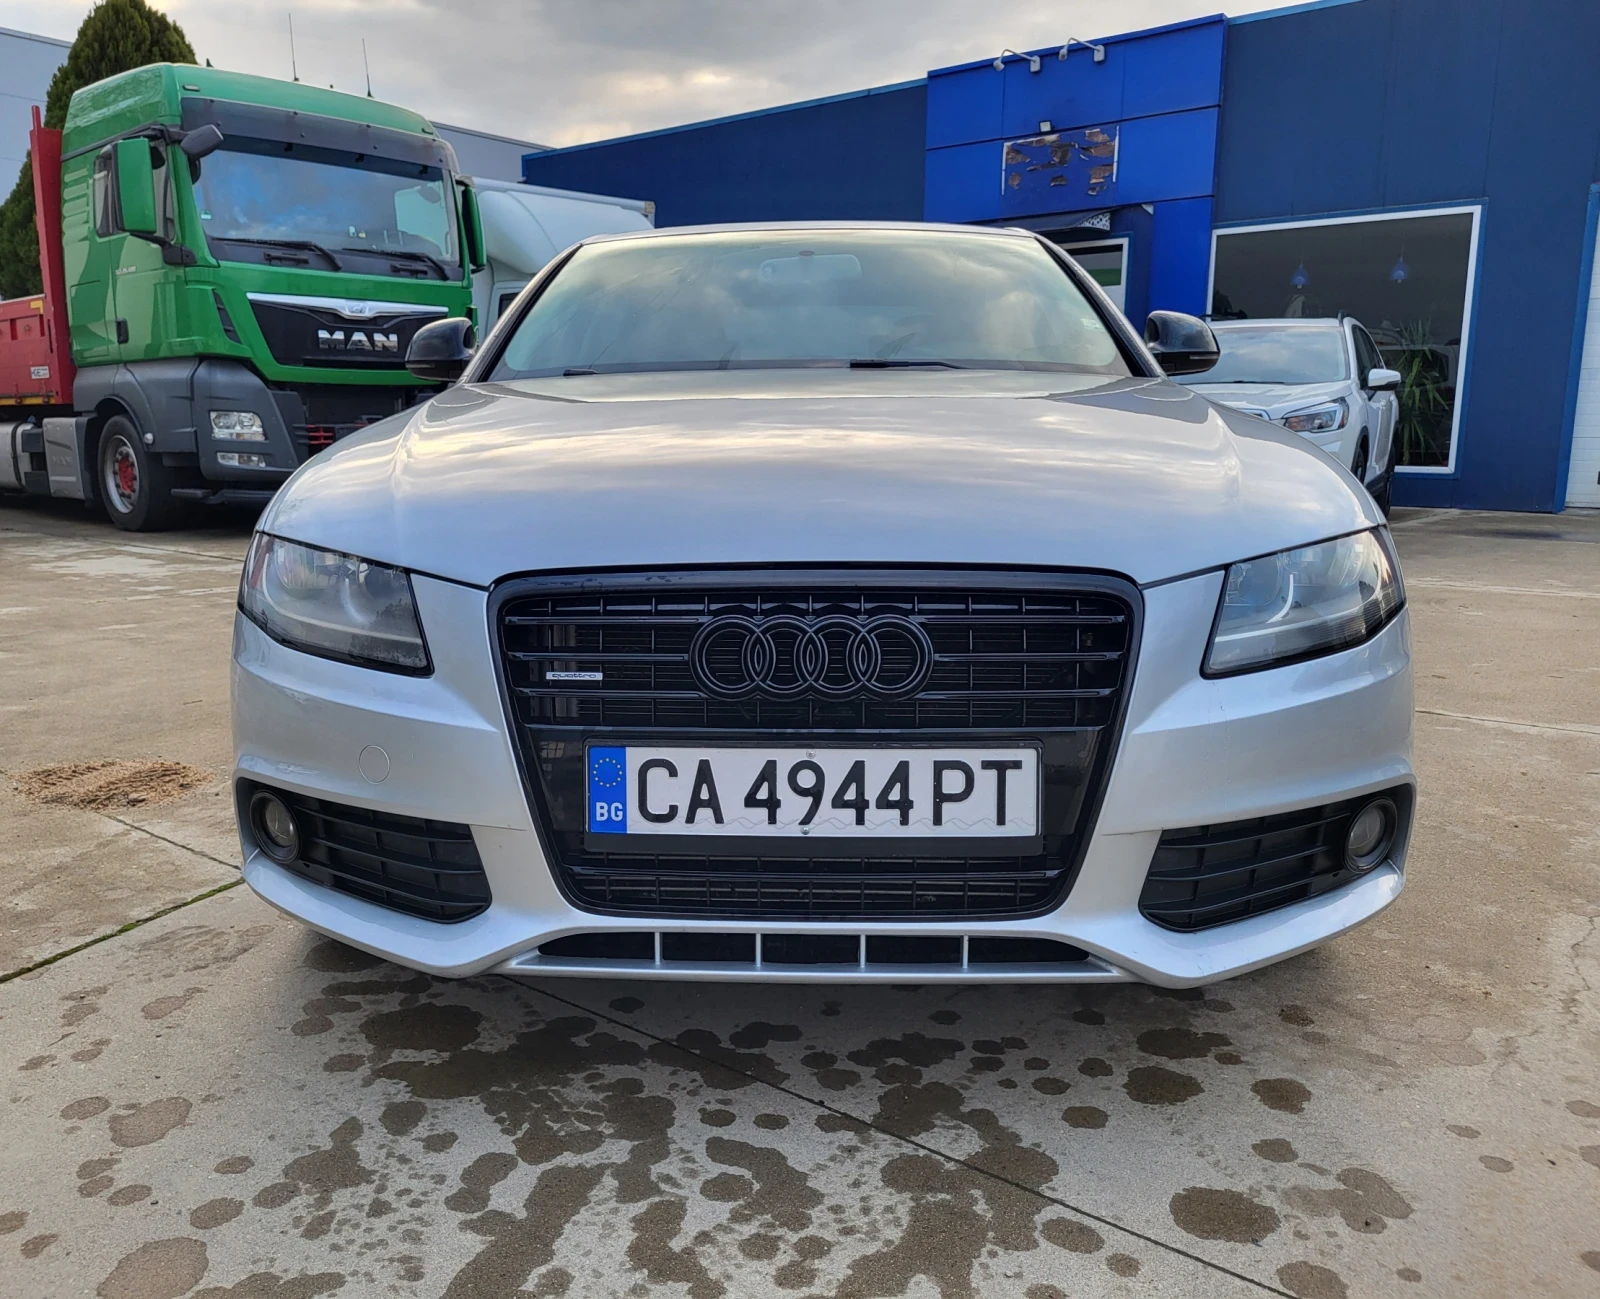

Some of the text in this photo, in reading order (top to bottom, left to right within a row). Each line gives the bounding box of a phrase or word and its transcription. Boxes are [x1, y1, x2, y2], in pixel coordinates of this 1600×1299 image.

[317, 328, 399, 353] MAN
[551, 672, 597, 680] quattro
[637, 757, 1023, 827] CA 4944 PT
[595, 802, 624, 822] BG
